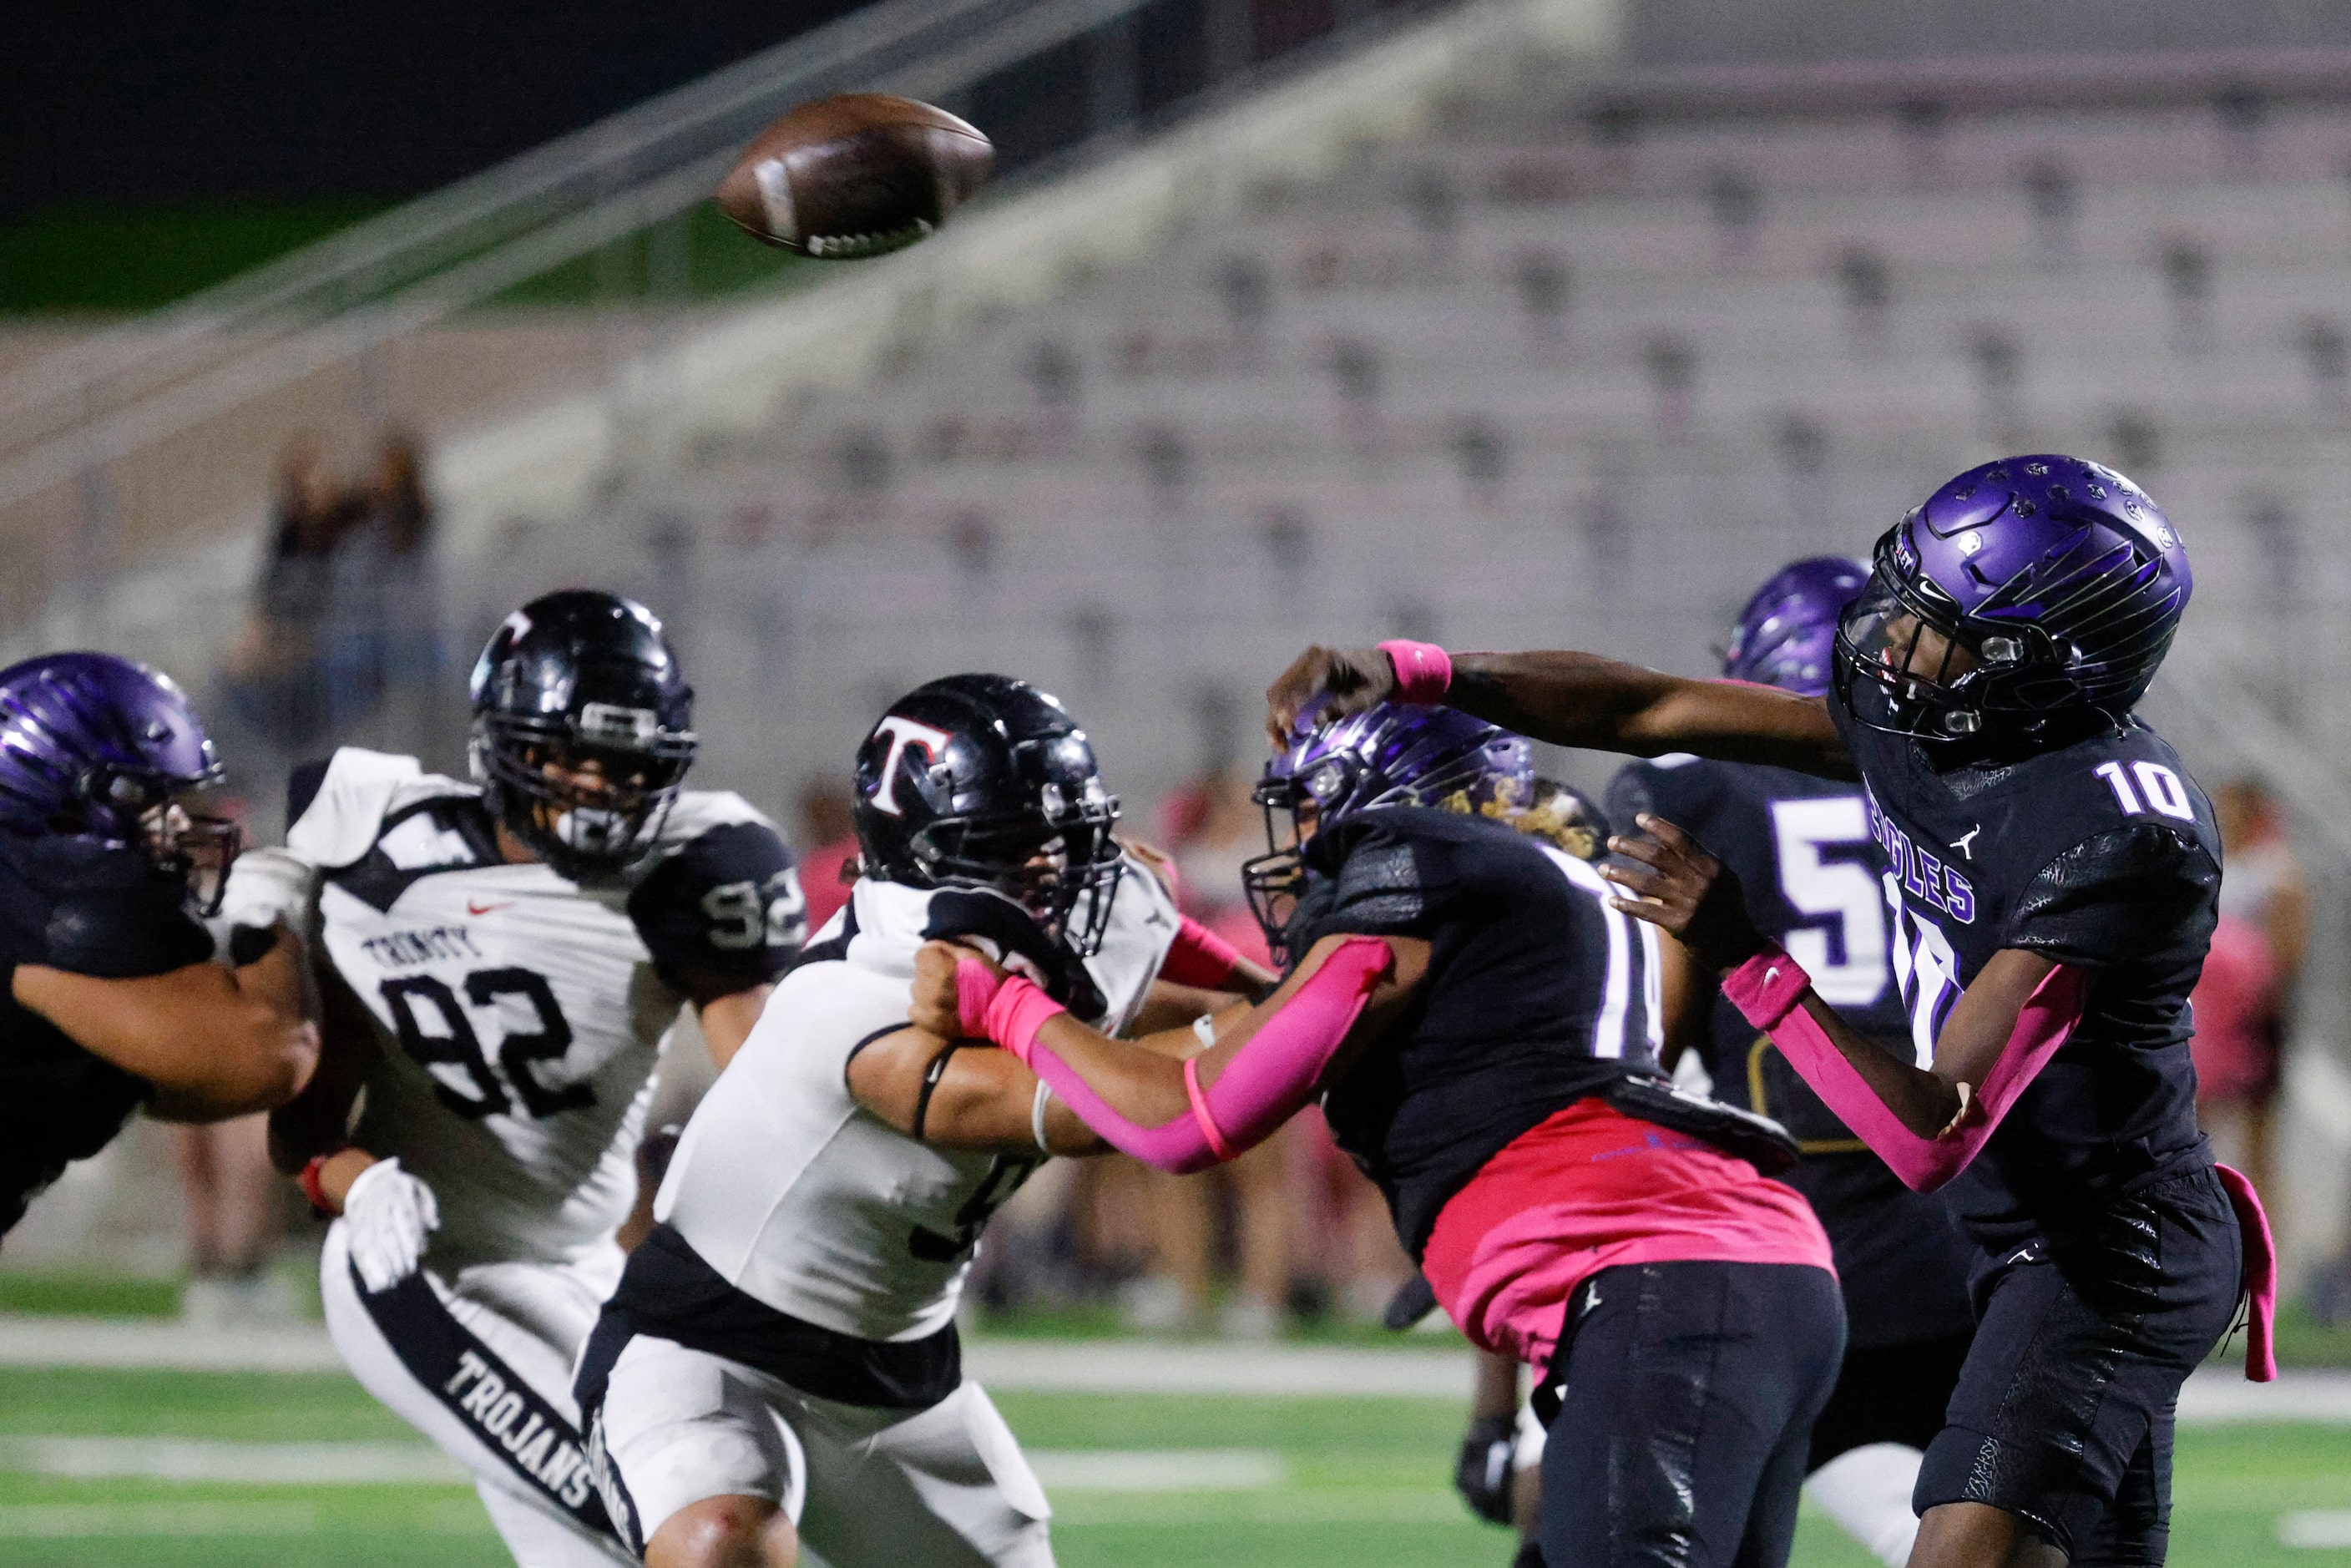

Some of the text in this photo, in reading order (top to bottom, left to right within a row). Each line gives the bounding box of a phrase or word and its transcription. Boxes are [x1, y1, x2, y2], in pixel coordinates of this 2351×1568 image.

[870, 715, 954, 819] T
[2092, 759, 2197, 823] 10
[361, 925, 483, 967] TRINITY
[700, 867, 807, 949] 92
[1767, 796, 1890, 1008] 5
[378, 966, 599, 1120] 92
[444, 1348, 596, 1510] TROJANS
